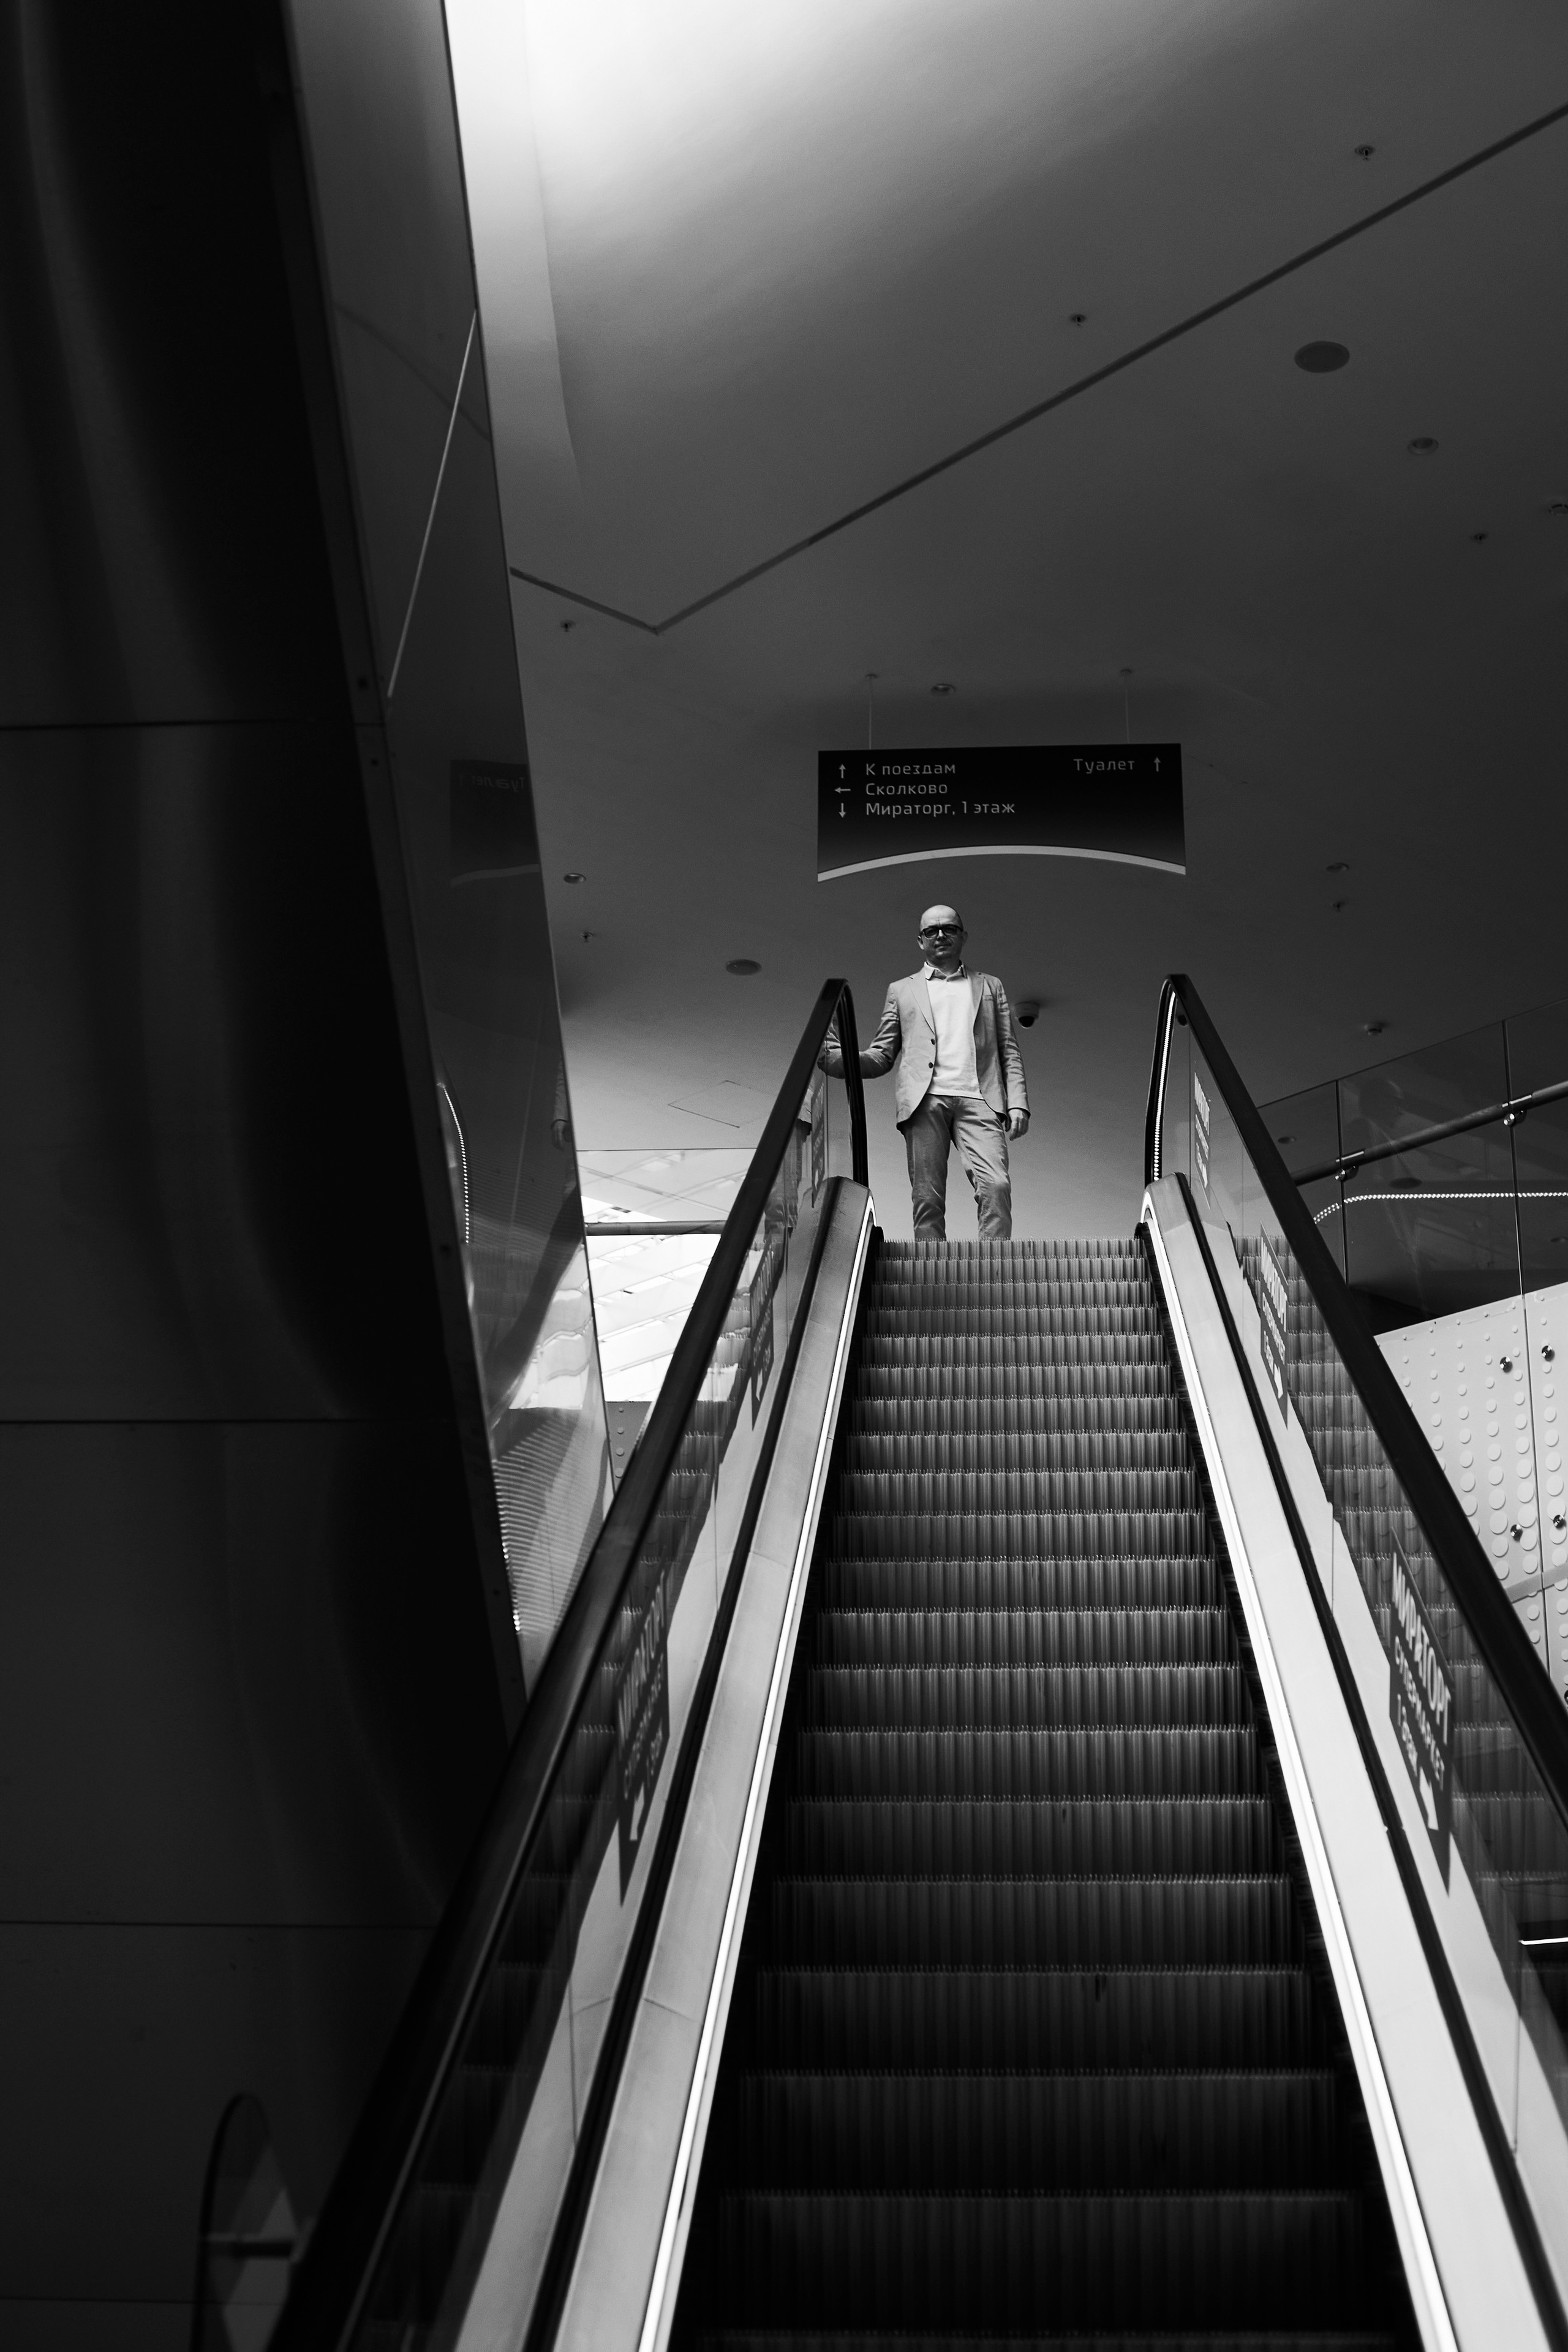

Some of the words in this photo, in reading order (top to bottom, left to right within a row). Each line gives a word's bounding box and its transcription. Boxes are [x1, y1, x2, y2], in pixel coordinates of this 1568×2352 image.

[866, 764, 875, 775] К
[882, 763, 956, 776] поездам
[1074, 758, 1135, 774] Туалет
[865, 783, 948, 795] Сколково
[866, 802, 955, 818] Мираторг,
[962, 801, 968, 814] 1
[973, 802, 1016, 814] этаж
[1261, 1237, 1287, 1332] МИРАТОРГ
[1392, 1552, 1450, 1746] МИРАТОРГ
[1395, 1636, 1444, 1790] СУПЕРМАРКЕТ
